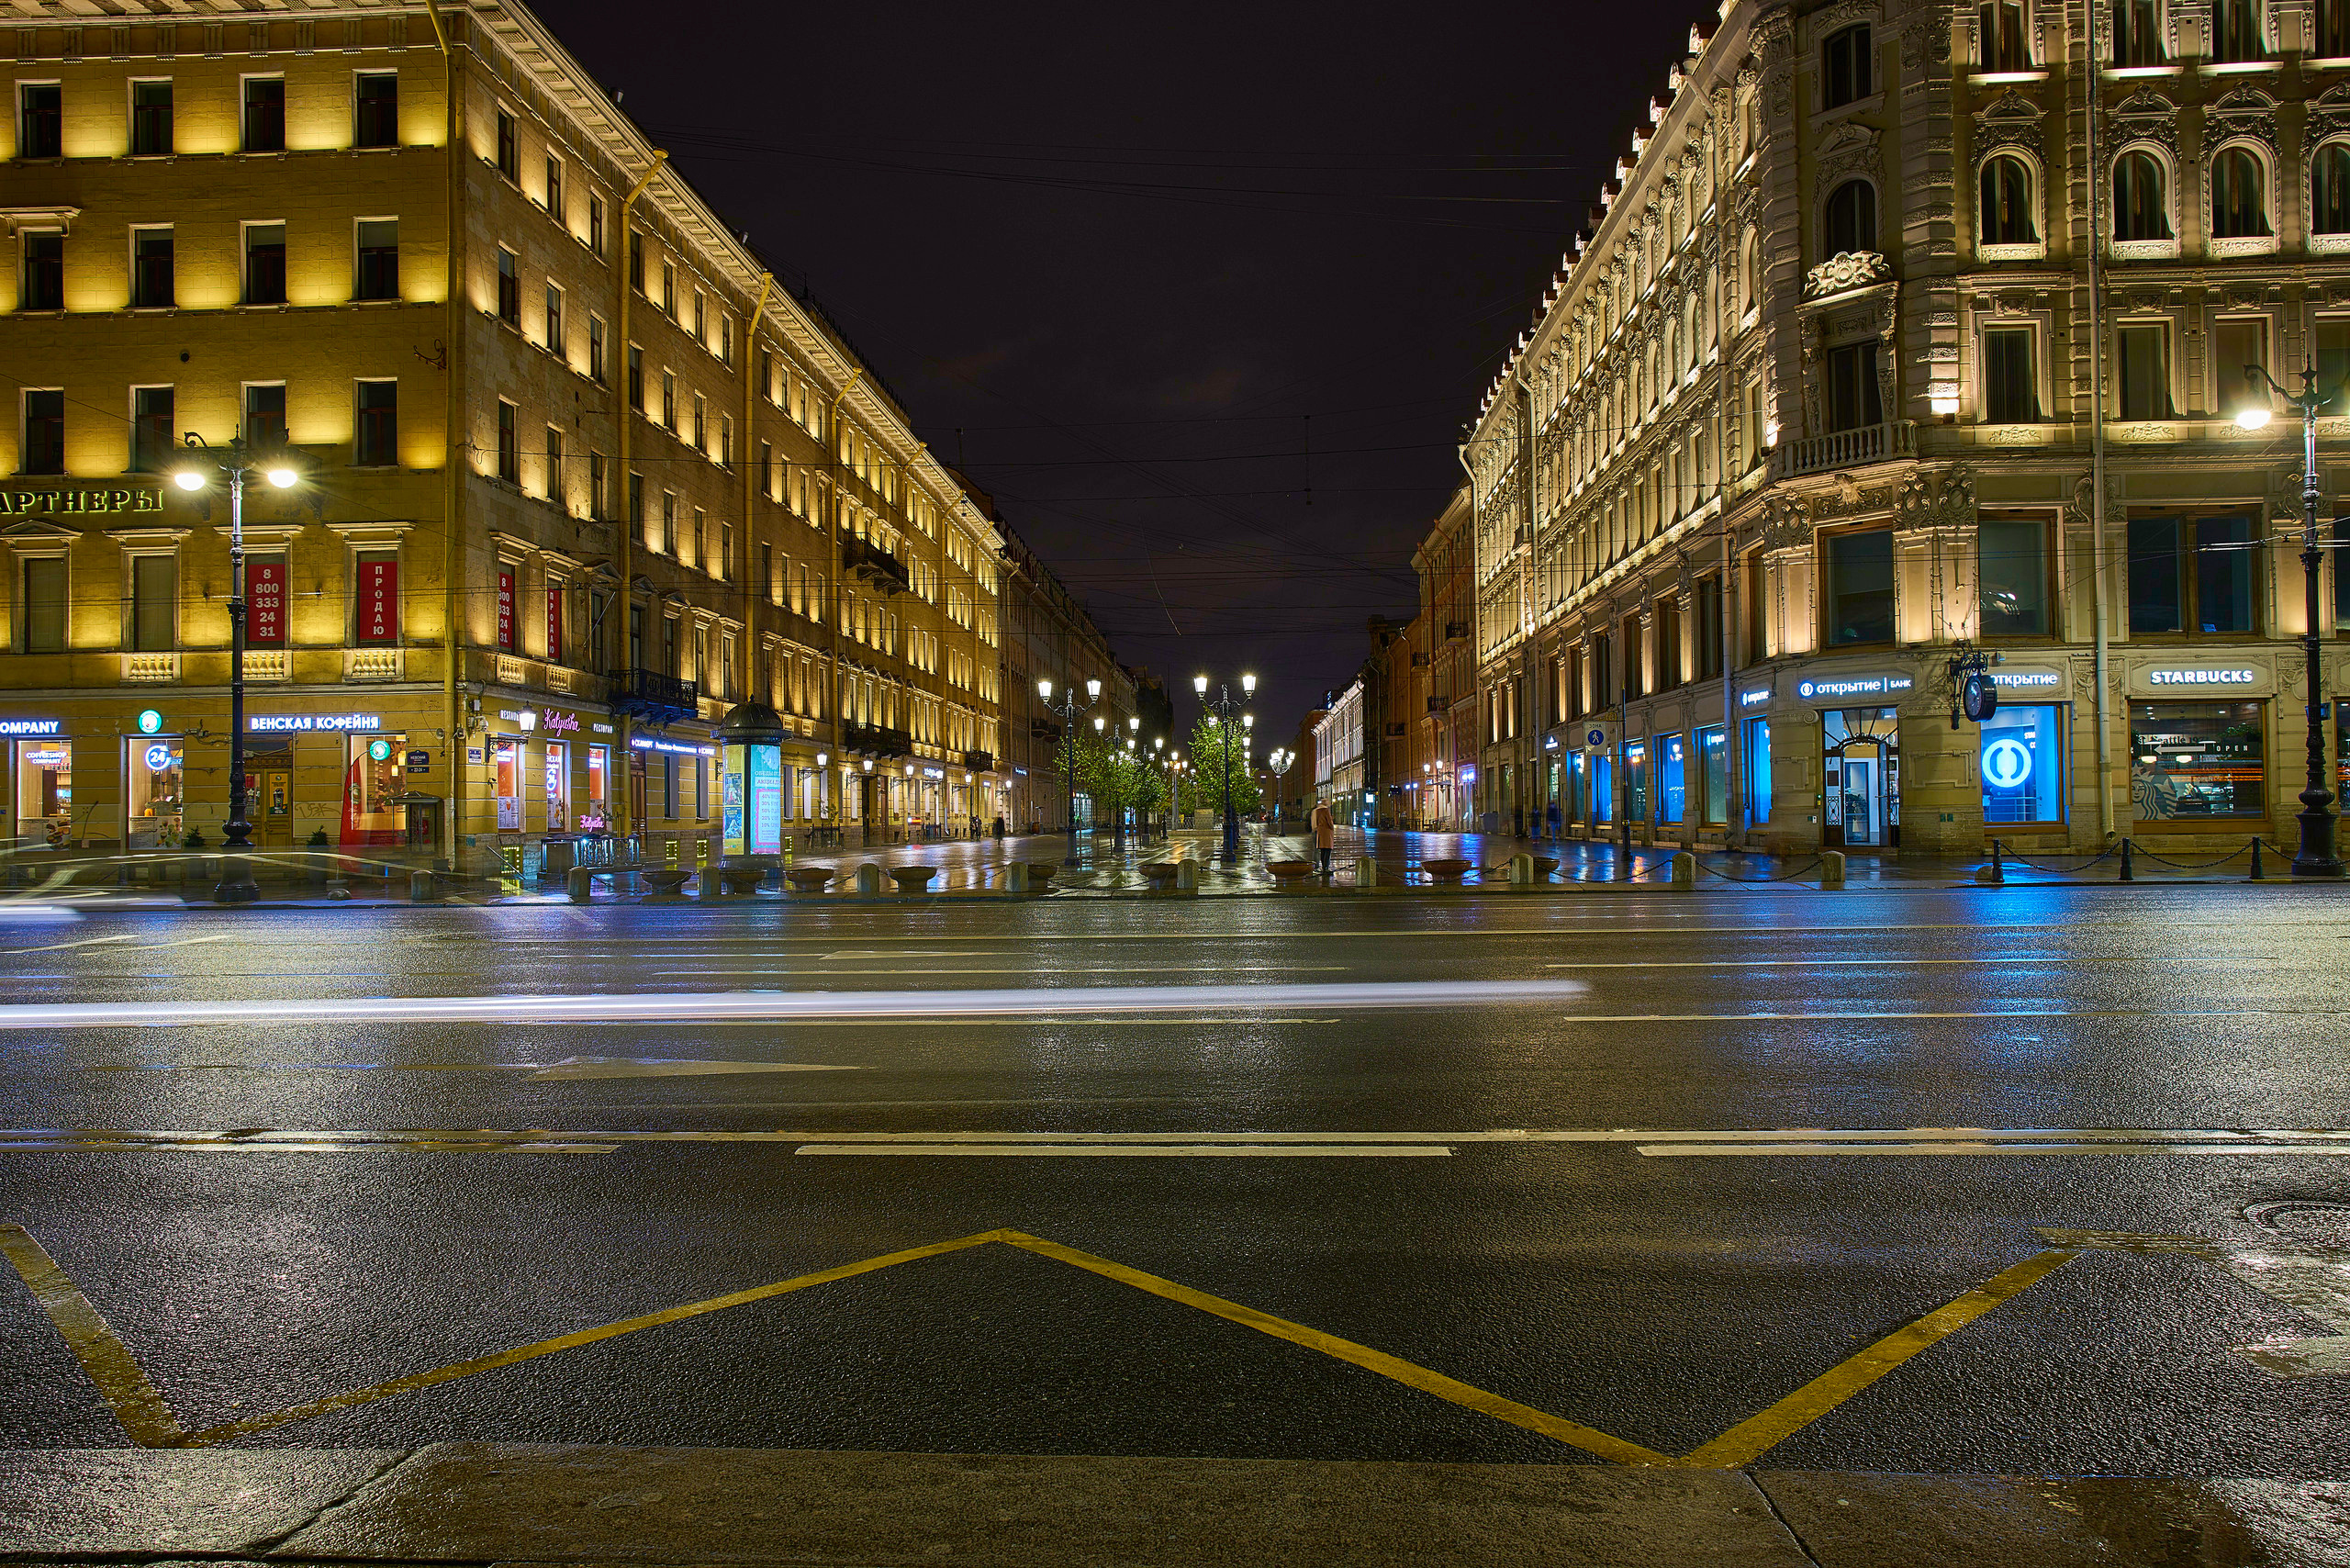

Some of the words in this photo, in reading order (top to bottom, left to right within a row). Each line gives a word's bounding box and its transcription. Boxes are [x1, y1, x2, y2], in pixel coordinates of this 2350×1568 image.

[263, 568, 272, 579] 8
[255, 583, 279, 594] 800
[501, 577, 507, 588] 8
[255, 598, 280, 608] 333
[373, 566, 385, 635] ПРОДАЮ
[259, 611, 275, 622] 24
[499, 618, 509, 630] 24
[259, 626, 275, 637] 31
[499, 632, 509, 644] 31
[2151, 670, 2254, 684] STARBUCKS
[1817, 679, 1882, 695] открытие
[1890, 678, 1911, 689] БАНК
[251, 717, 312, 730] ВЕНСКАЯ
[316, 714, 380, 730] КОФЕЙНЯ
[543, 708, 580, 737] Katyusha
[150, 751, 166, 763] 24
